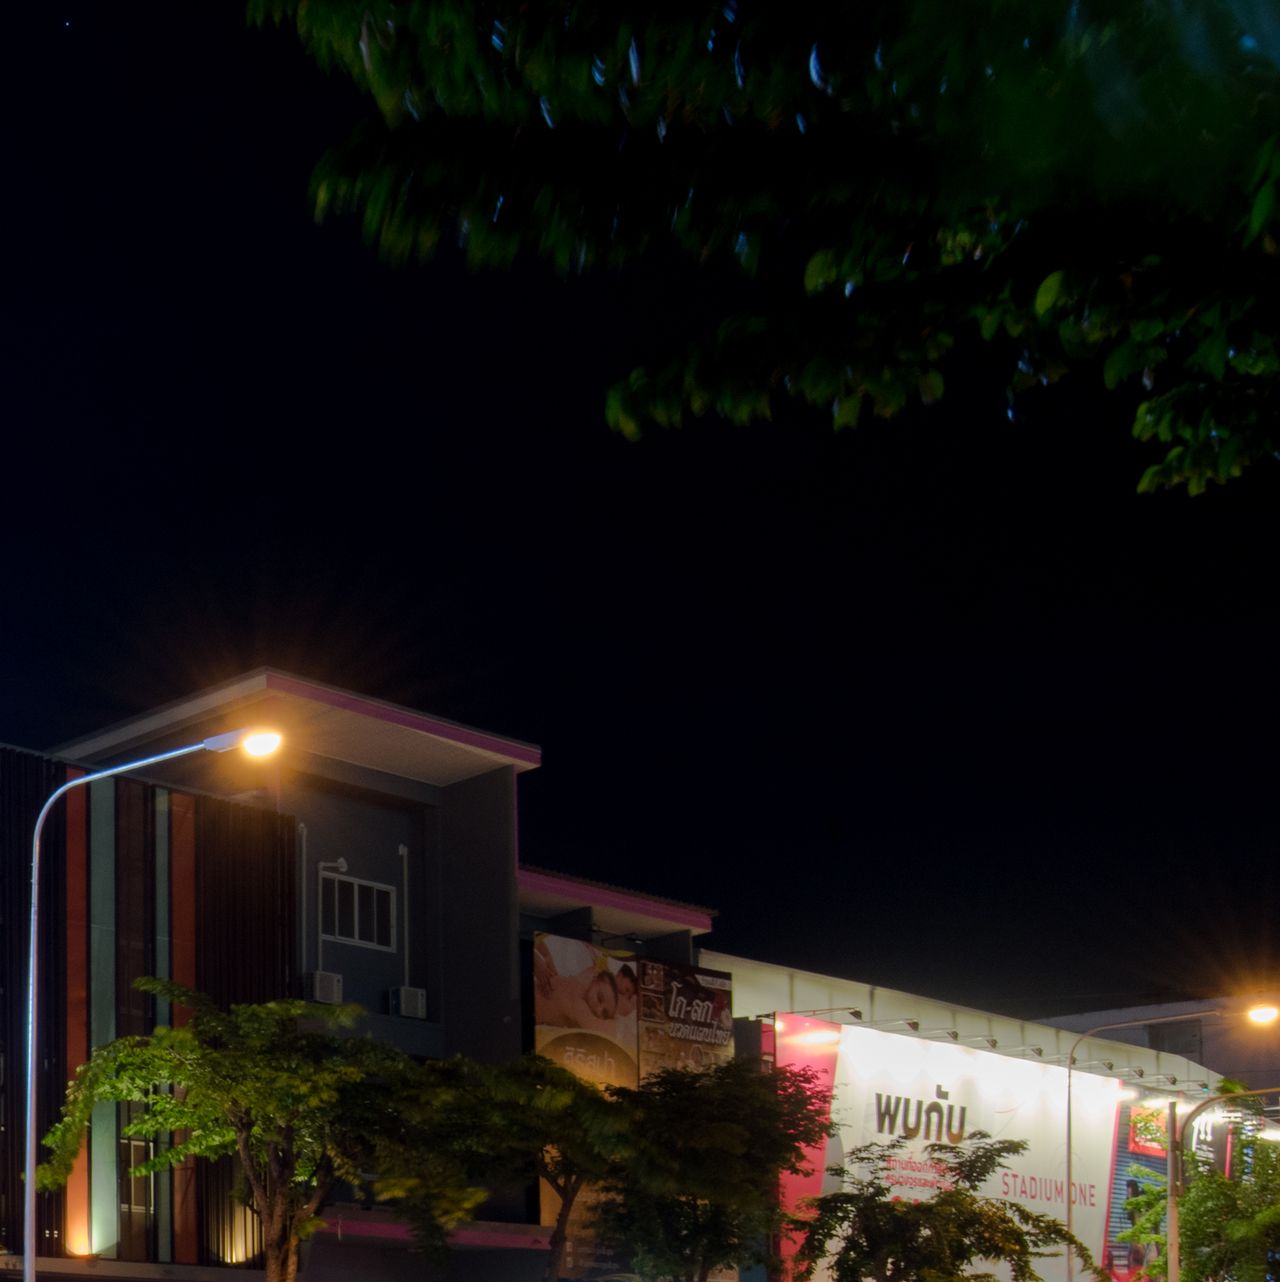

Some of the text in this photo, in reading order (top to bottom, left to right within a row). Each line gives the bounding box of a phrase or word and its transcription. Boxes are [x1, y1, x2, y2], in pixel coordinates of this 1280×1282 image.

[875, 1084, 967, 1145] พบกับ
[1001, 1172, 1096, 1207] STADIUM ONE
